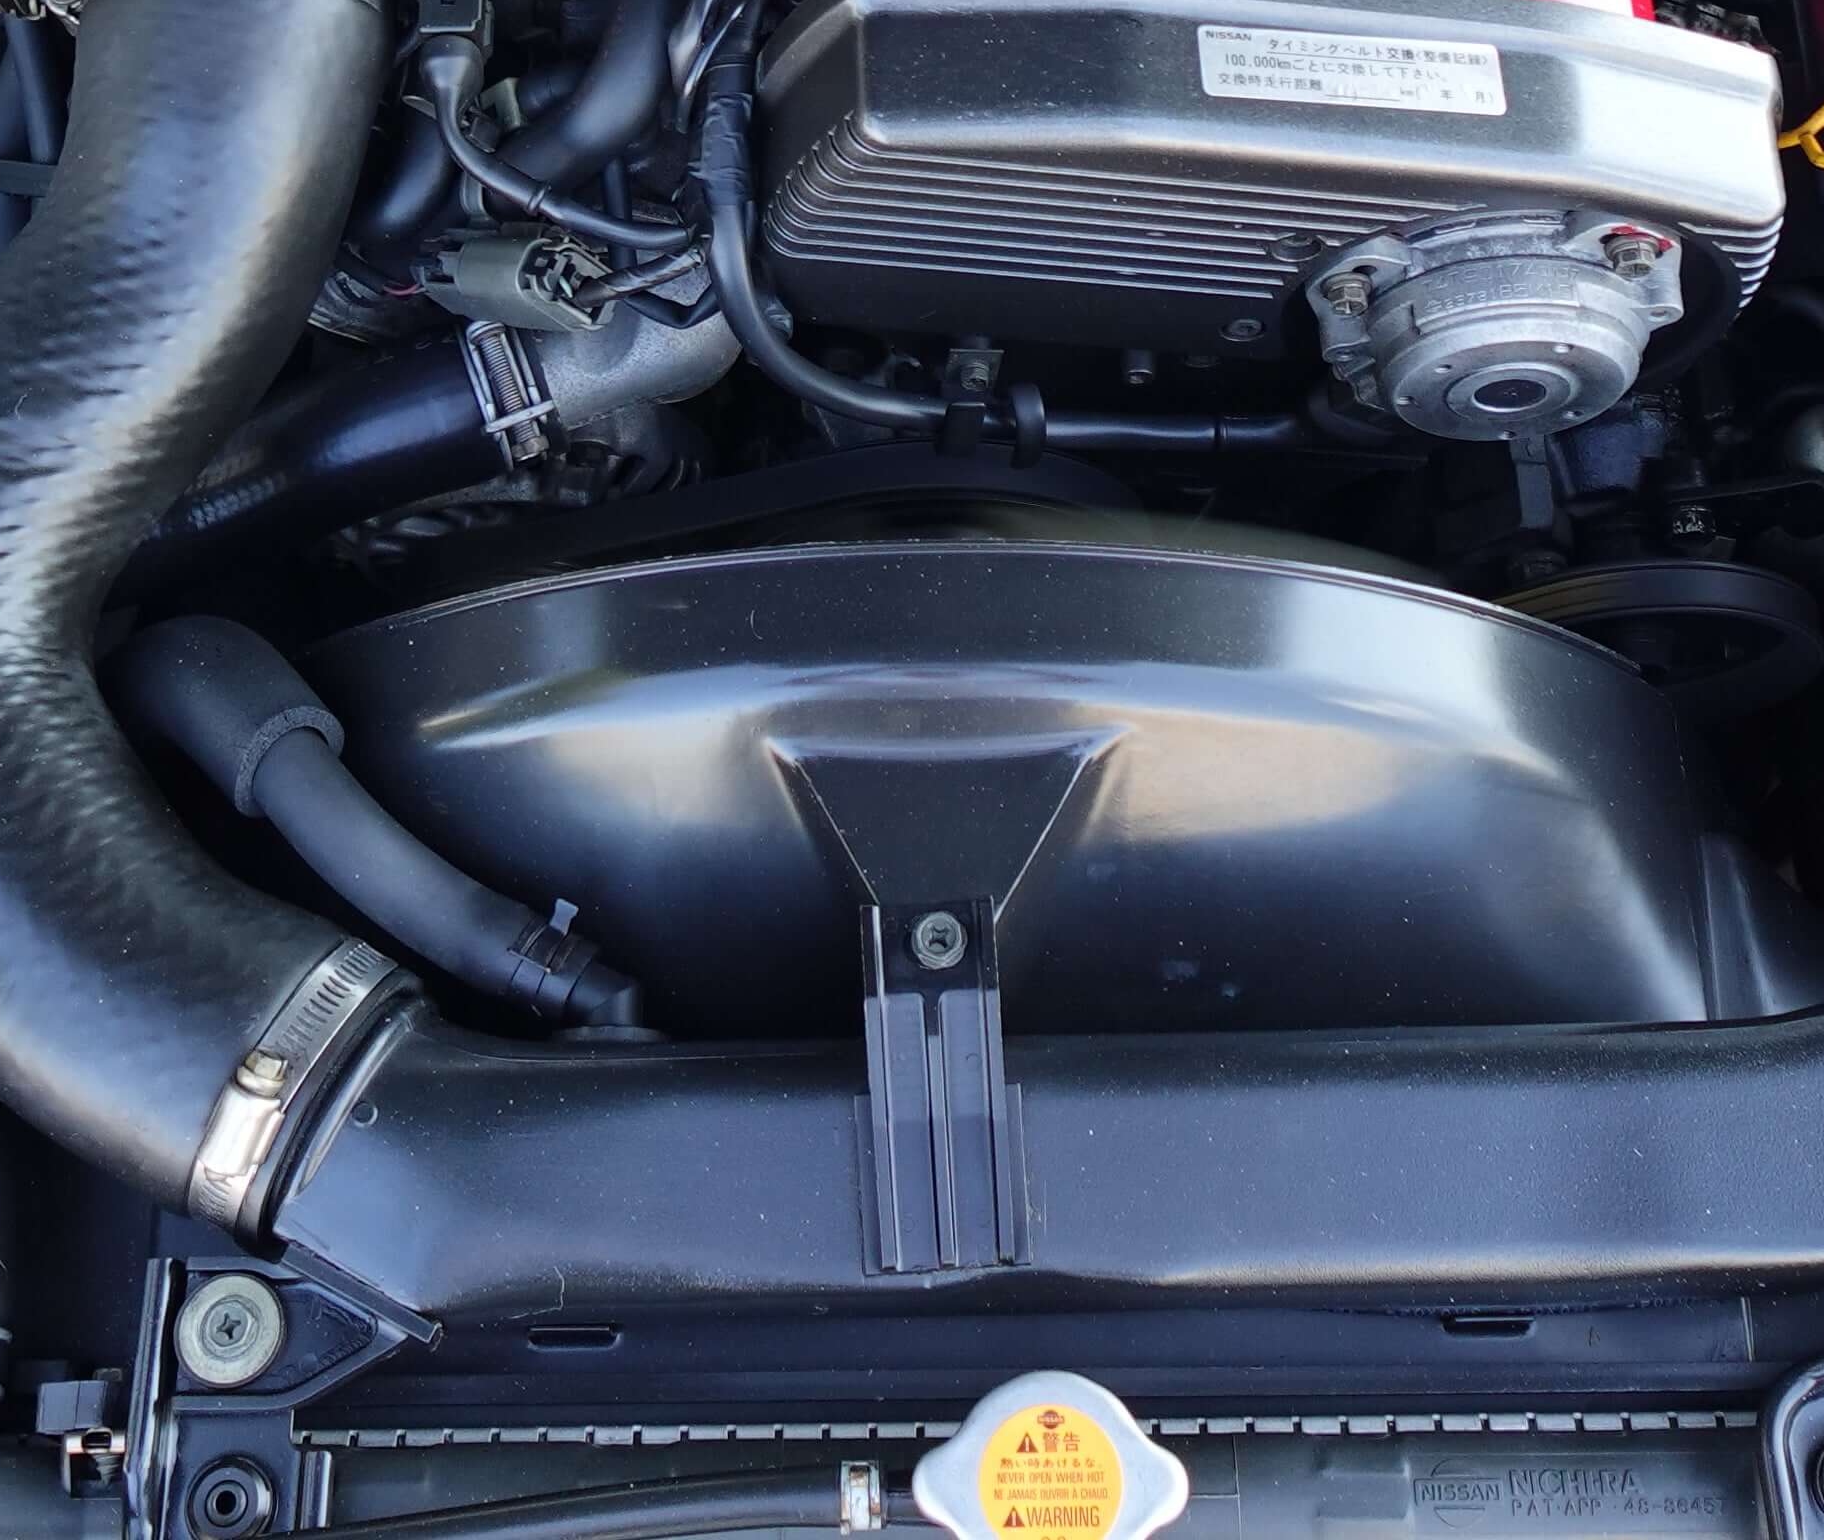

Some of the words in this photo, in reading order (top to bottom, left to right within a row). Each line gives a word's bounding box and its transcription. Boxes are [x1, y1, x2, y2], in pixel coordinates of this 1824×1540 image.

[1205, 30, 1252, 42] NISSAN
[1042, 1431, 1081, 1453] 警告
[996, 1471, 1025, 1485] NEVER
[1028, 1471, 1052, 1485] OPEN
[1055, 1471, 1084, 1484] WHEN
[1087, 1470, 1104, 1484] HOT
[993, 1488, 1004, 1501] NE
[1006, 1488, 1037, 1501] JAMAIS
[1039, 1488, 1070, 1501] OUVRIR
[1420, 1482, 1502, 1502] NISSAN
[1026, 1505, 1101, 1529] WARNING
